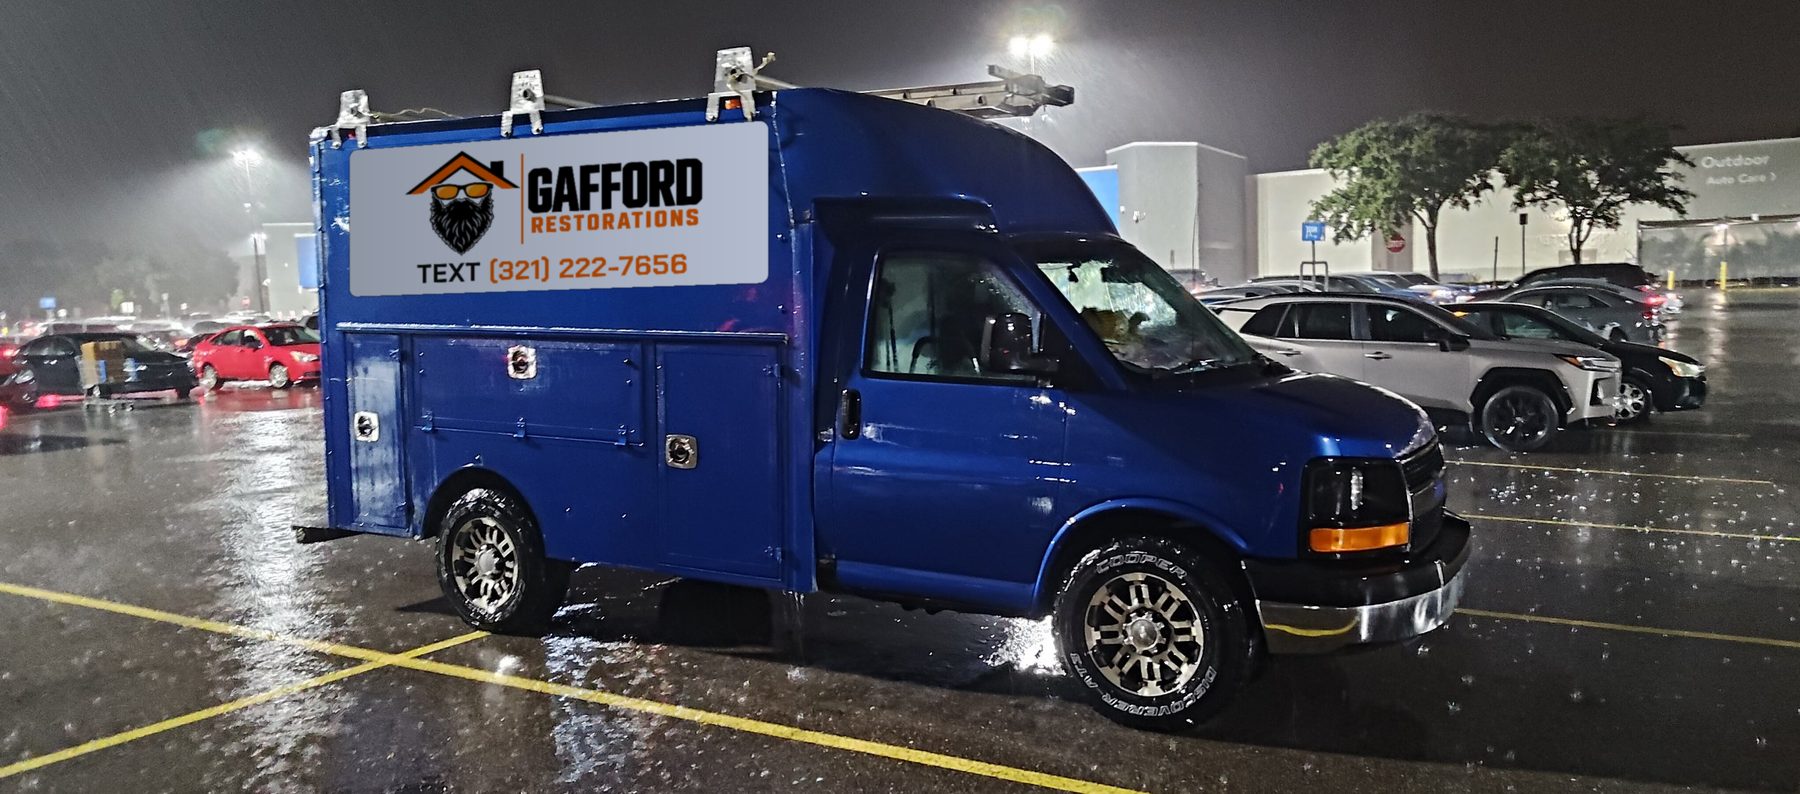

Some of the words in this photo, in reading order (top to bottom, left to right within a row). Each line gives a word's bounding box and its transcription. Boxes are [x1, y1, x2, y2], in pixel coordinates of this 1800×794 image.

[1701, 154, 1770, 168] Outdoor
[527, 157, 704, 214] GAFFORD
[1706, 176, 1735, 184] Auto
[1738, 173, 1767, 183] Care
[530, 208, 700, 234] RESTORATIONS
[417, 262, 481, 284] TEXT
[490, 256, 550, 284] (321)
[559, 253, 688, 281] 222-7656
[1096, 553, 1188, 580] COOPER
